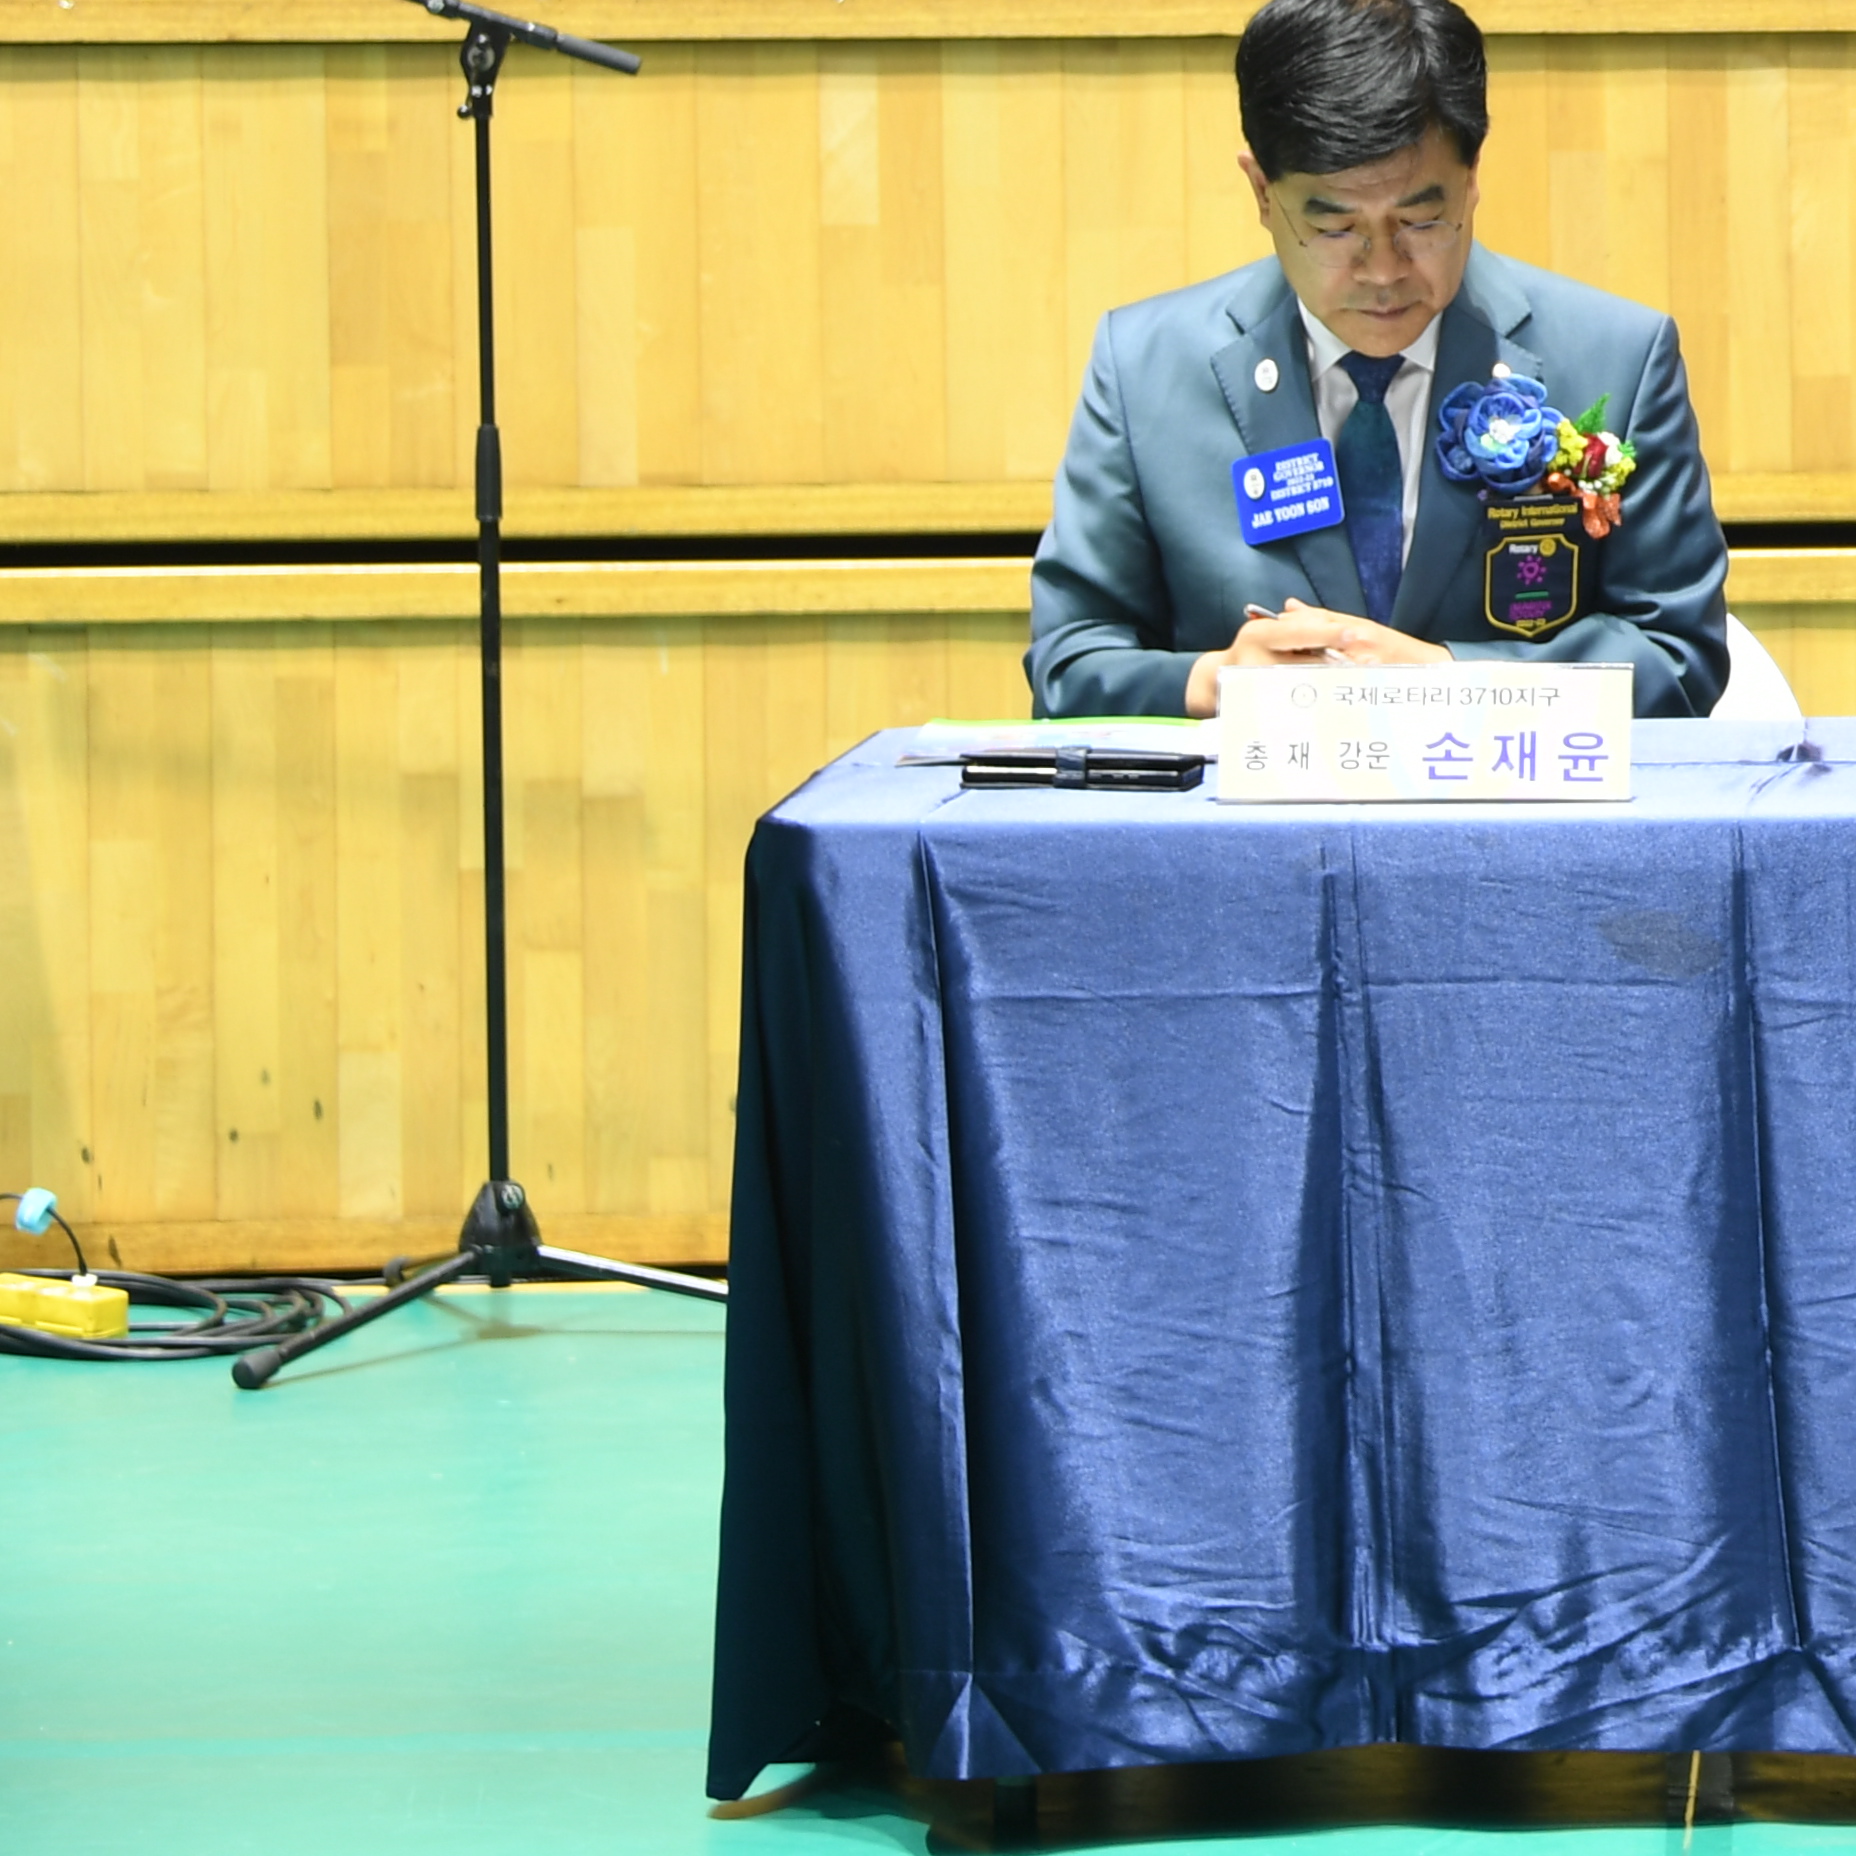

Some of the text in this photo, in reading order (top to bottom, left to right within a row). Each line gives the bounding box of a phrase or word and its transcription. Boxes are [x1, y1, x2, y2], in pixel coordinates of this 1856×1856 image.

[1333, 684, 1561, 707] 국제로타리 3710지구
[1338, 741, 1391, 771] 강운
[1422, 730, 1610, 783] 손재윤
